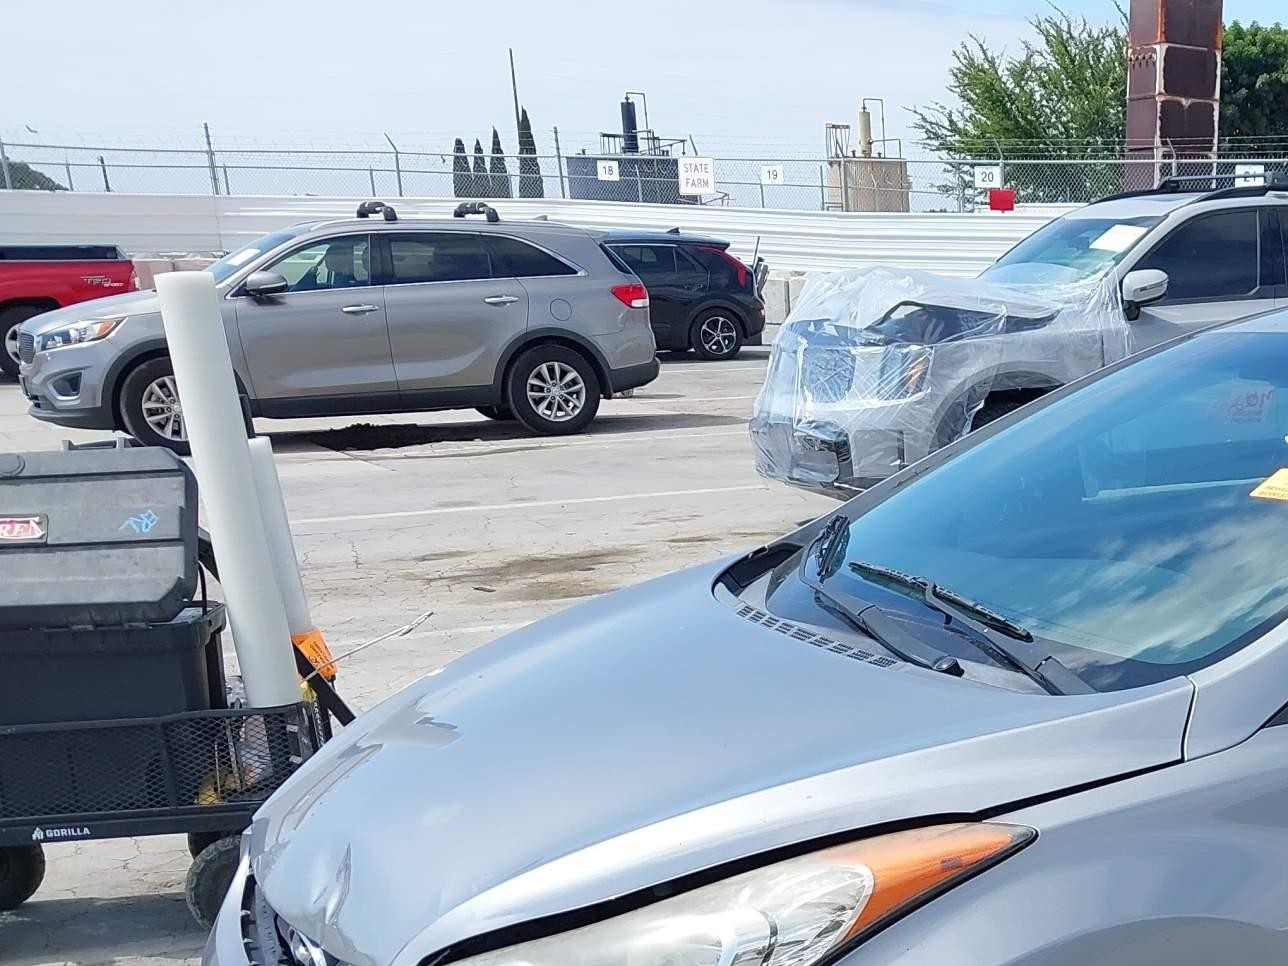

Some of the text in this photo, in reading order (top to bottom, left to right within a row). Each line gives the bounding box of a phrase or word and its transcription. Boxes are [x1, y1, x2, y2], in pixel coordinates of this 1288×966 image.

[602, 165, 613, 176] 18
[683, 163, 709, 174] STATE
[767, 169, 778, 180] 19
[981, 171, 994, 182] 20
[685, 177, 709, 189] FARM
[45, 827, 91, 838] GORILLA
